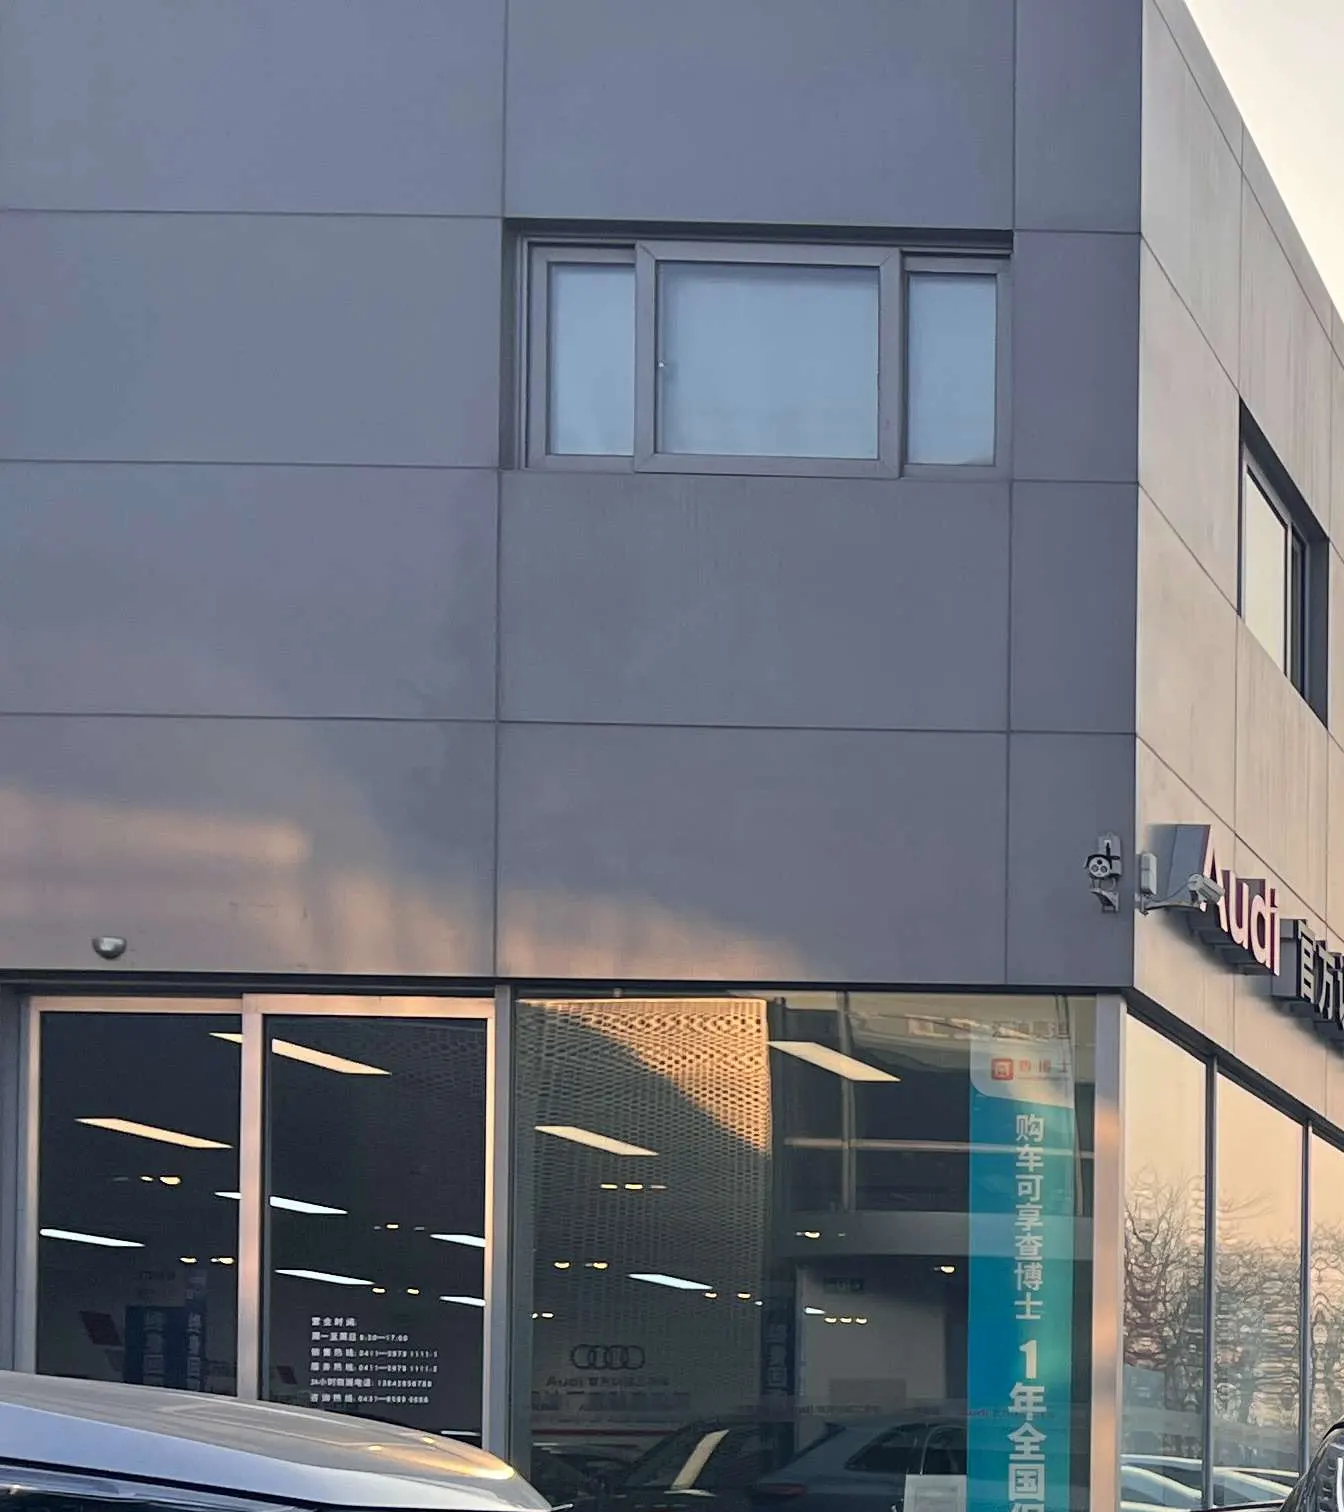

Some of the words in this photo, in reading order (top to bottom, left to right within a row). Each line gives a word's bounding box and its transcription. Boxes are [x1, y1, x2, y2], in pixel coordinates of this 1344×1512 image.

[1200, 824, 1280, 977] Audi
[1013, 1113, 1045, 1321] 购车可享查博士
